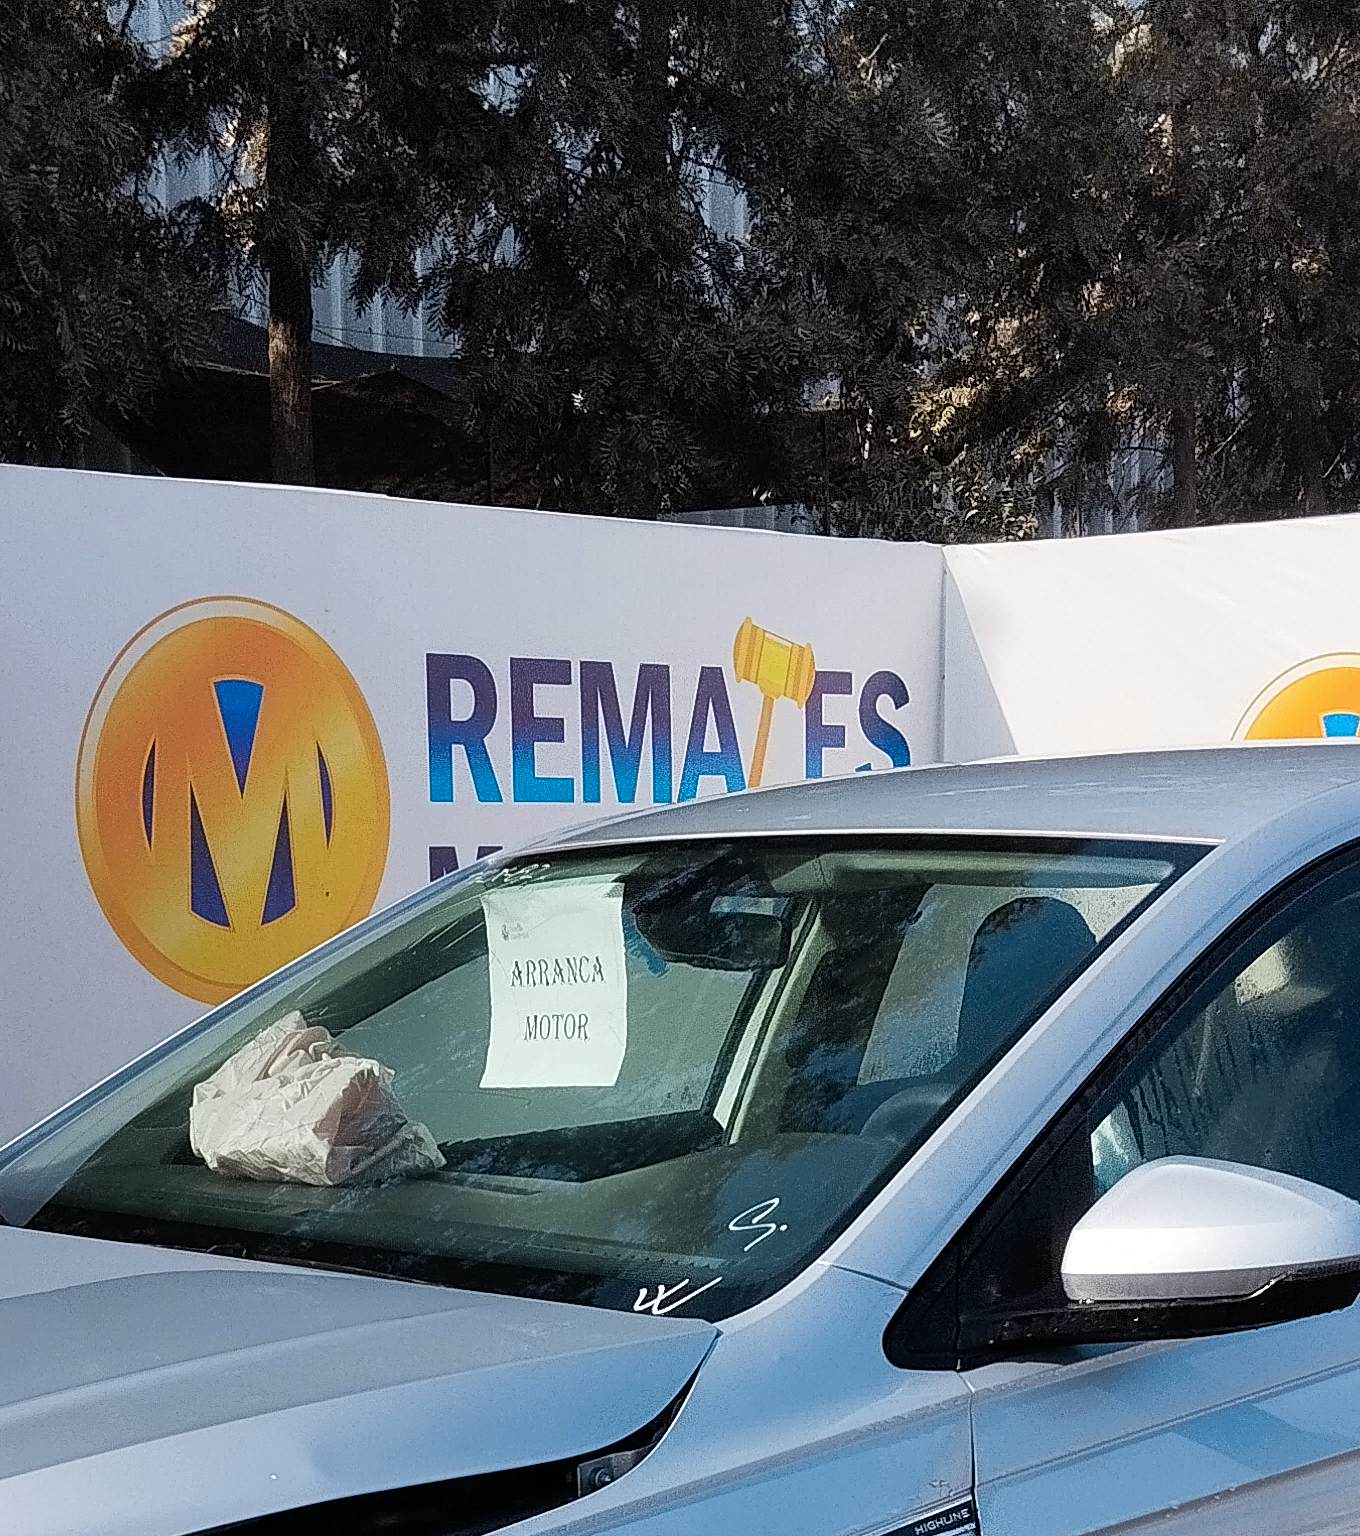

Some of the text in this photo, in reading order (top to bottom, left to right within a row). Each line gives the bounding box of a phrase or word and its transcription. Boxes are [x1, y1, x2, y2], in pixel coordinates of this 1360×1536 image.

[510, 956, 606, 988] ARRANCA
[523, 1013, 590, 1042] MOTOR
[914, 1508, 971, 1536] HIGHLINE
